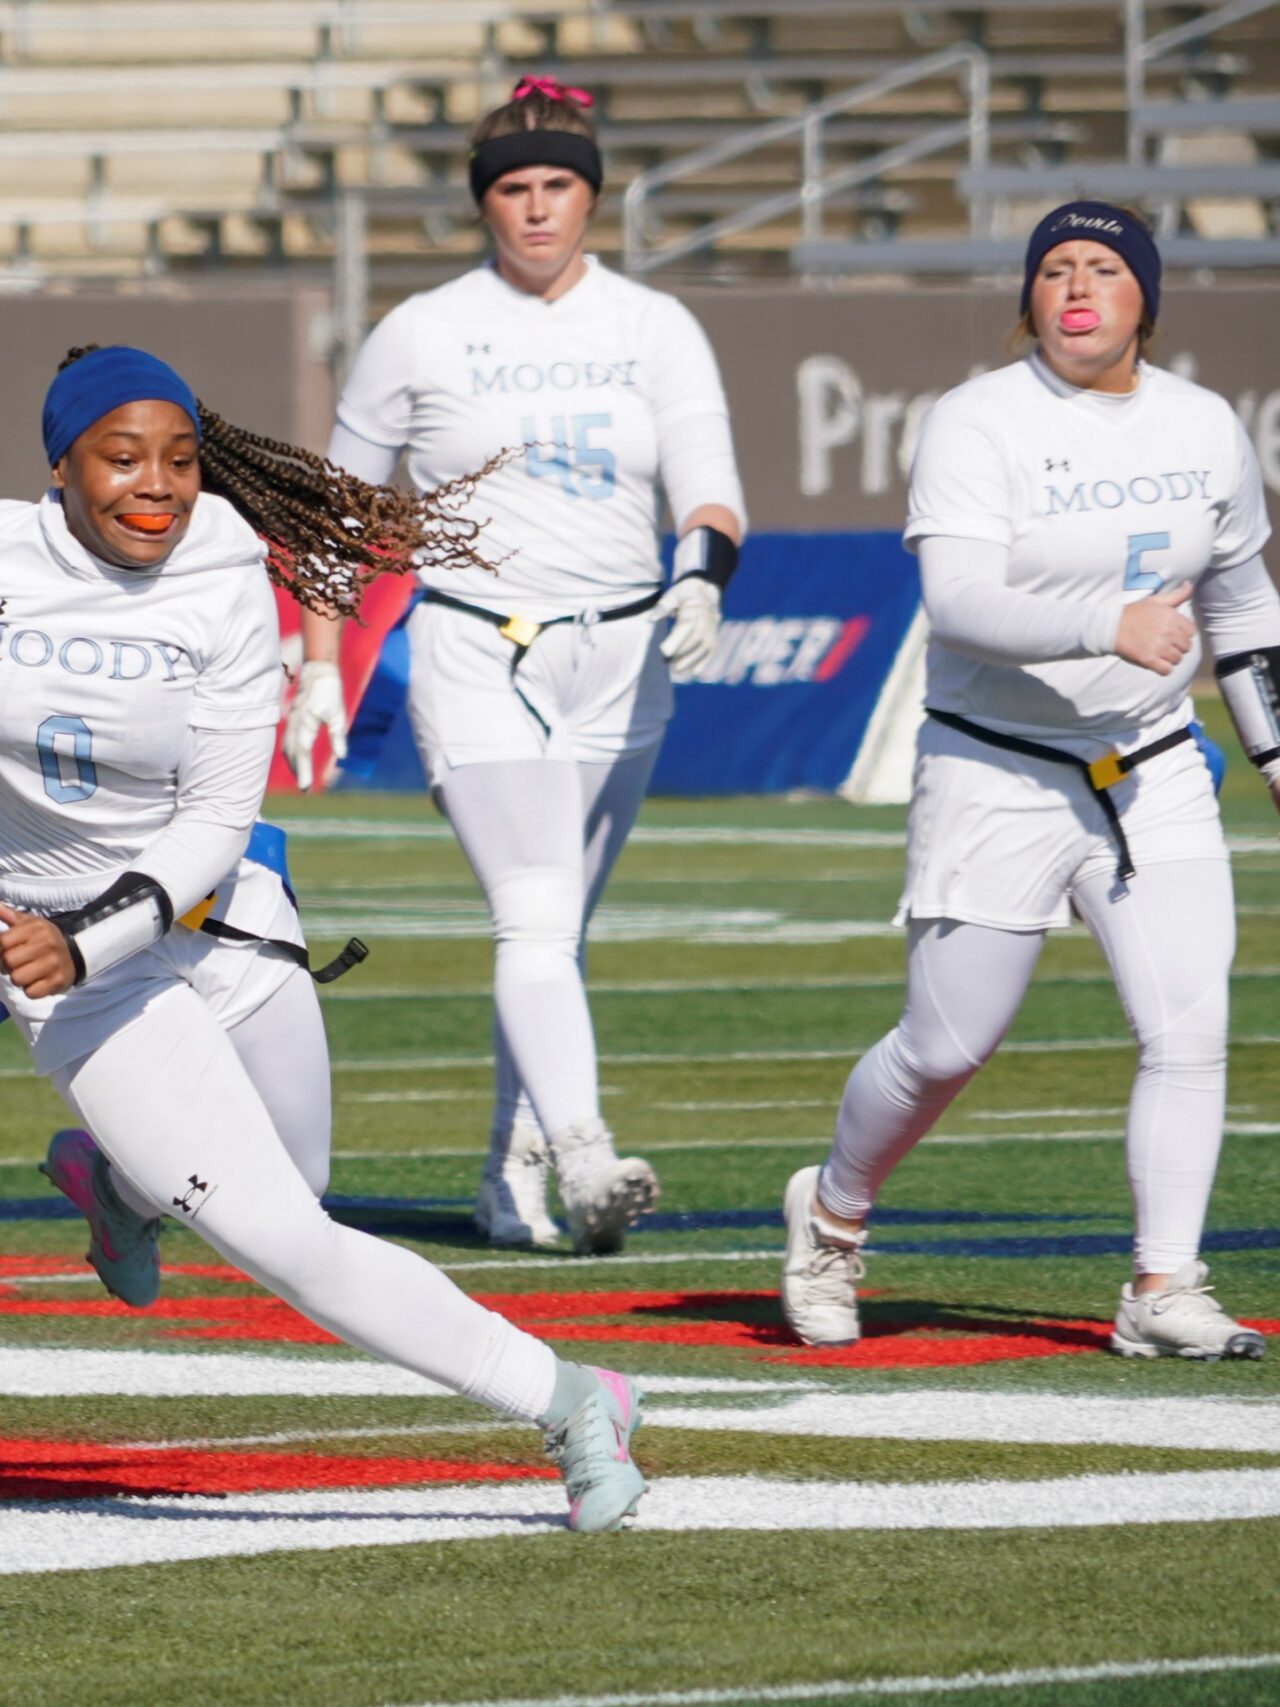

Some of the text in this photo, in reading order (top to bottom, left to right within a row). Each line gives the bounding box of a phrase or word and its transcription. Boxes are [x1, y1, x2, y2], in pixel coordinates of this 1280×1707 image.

[471, 361, 637, 396] MOODY
[521, 413, 616, 501] 45
[1044, 470, 1212, 516] MOODY
[36, 715, 97, 804] 0
